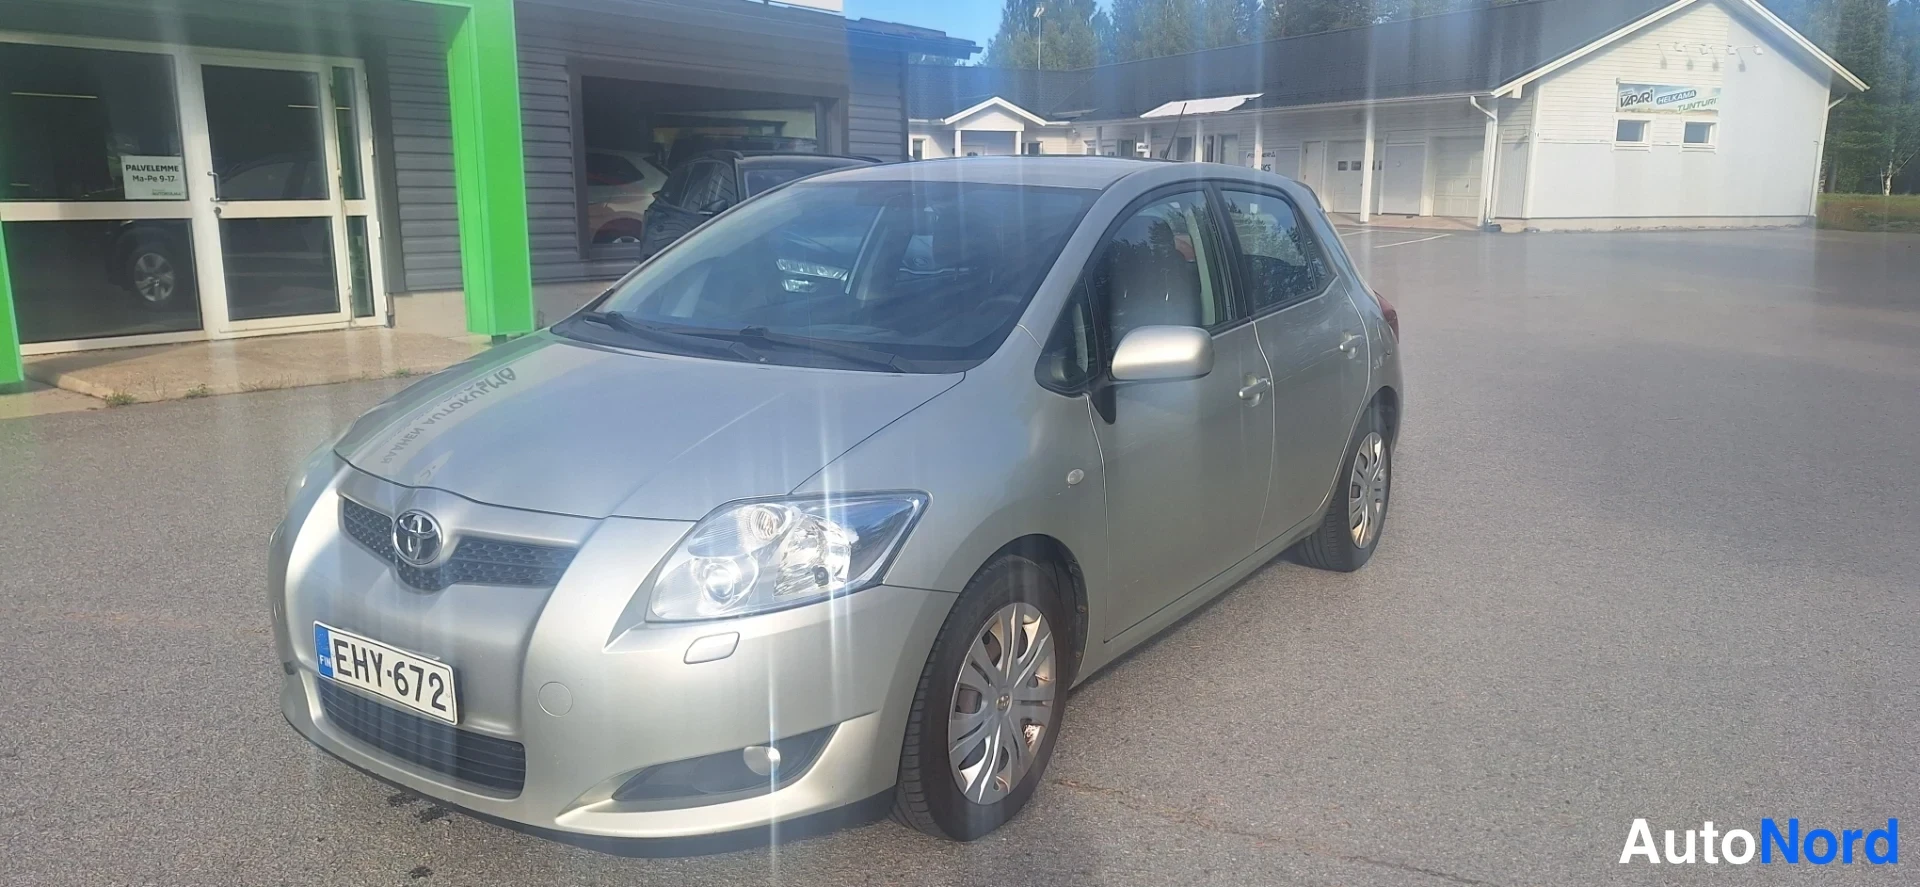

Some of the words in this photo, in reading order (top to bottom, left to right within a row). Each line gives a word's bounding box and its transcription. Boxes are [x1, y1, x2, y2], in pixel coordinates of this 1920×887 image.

[1658, 90, 1695, 105] HELKAMA
[1677, 98, 1717, 112] TUNTURI
[125, 164, 180, 172] PALVELEMME
[132, 175, 158, 183] Ma-Pe
[319, 654, 331, 668] FIN
[333, 638, 447, 712] EHY-672
